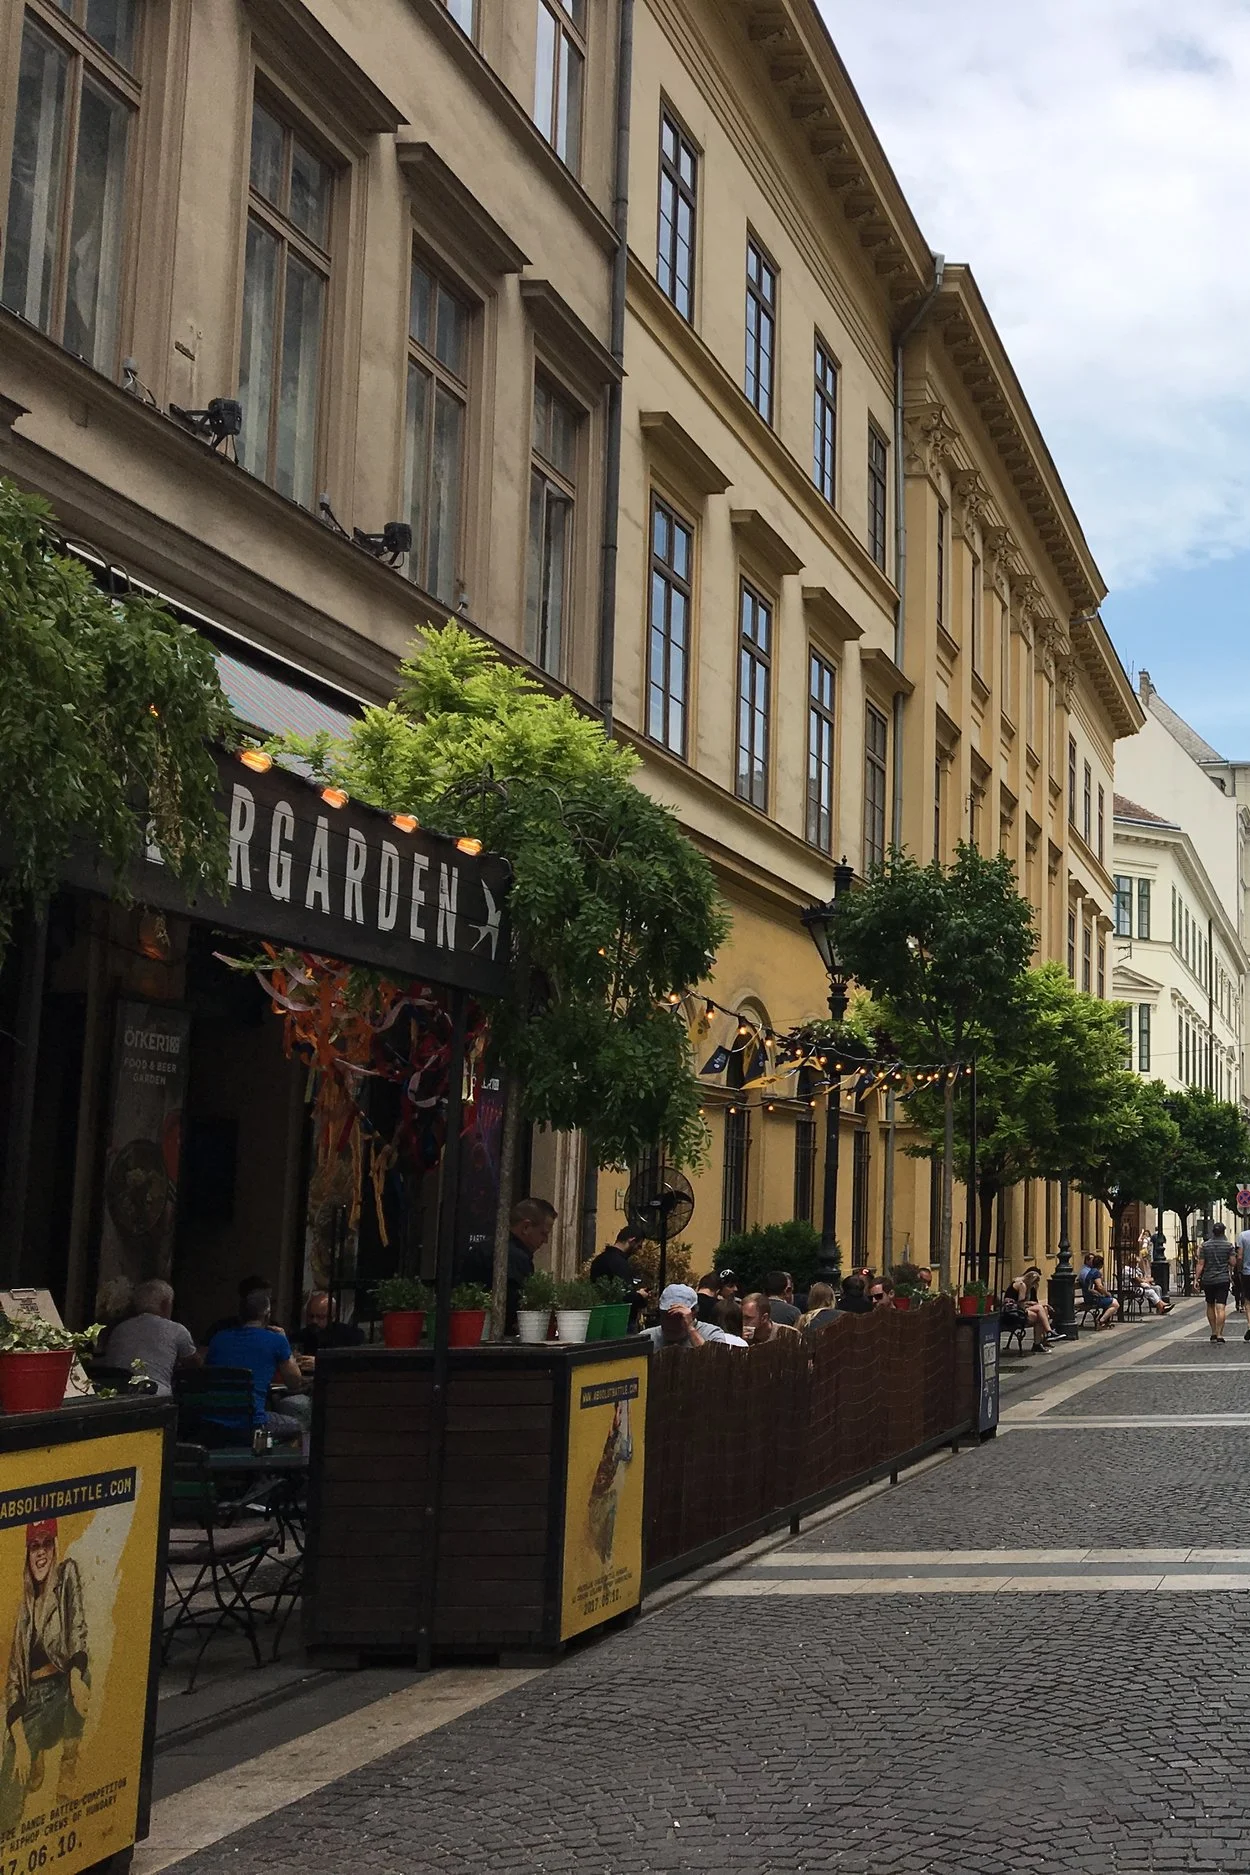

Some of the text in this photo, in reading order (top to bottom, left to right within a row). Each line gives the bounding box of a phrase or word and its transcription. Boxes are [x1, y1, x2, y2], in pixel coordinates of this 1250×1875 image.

[145, 783, 459, 952] RGARDEN
[124, 1057, 177, 1074] FOOD & BEER
[133, 1073, 166, 1085] GARDEN
[21, 1814, 46, 1834] DANCE
[49, 1798, 79, 1820] BATTLE
[72, 1809, 82, 1823] OF
[86, 1795, 118, 1816] HUNGARY
